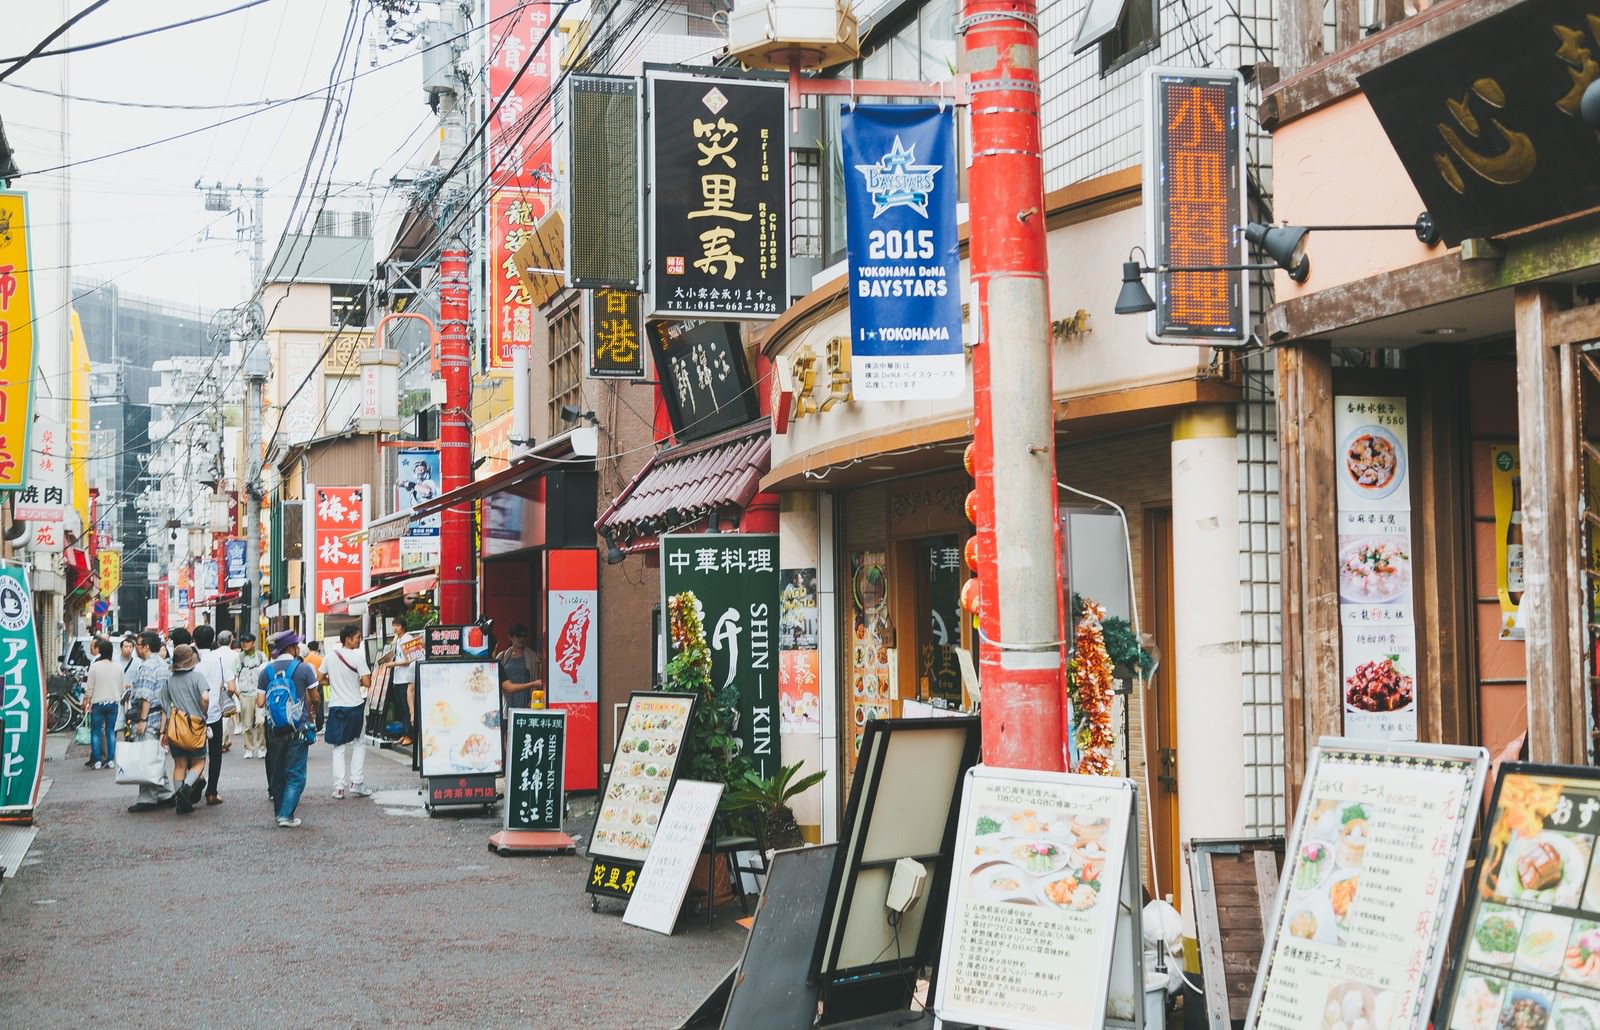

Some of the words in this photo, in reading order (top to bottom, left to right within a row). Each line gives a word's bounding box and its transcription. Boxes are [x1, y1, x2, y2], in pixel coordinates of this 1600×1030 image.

[529, 11, 548, 77] 中国料理
[760, 128, 769, 181] Erisu
[687, 117, 753, 281] 笑里寿
[759, 202, 767, 279] Restaurant
[769, 213, 777, 269] Chinese
[869, 230, 934, 259] 2015
[859, 267, 916, 278] YOKOHAMA
[919, 267, 946, 277] DeNA
[674, 287, 773, 301] 大小宴会承ります。
[859, 279, 947, 297] BAYSTARS
[879, 327, 949, 341] YOKOHAMA
[19, 485, 63, 505] 焼肉
[669, 547, 774, 575] 中華料理
[2, 638, 30, 796] アイスコーヒー
[516, 718, 562, 729] 中華料理
